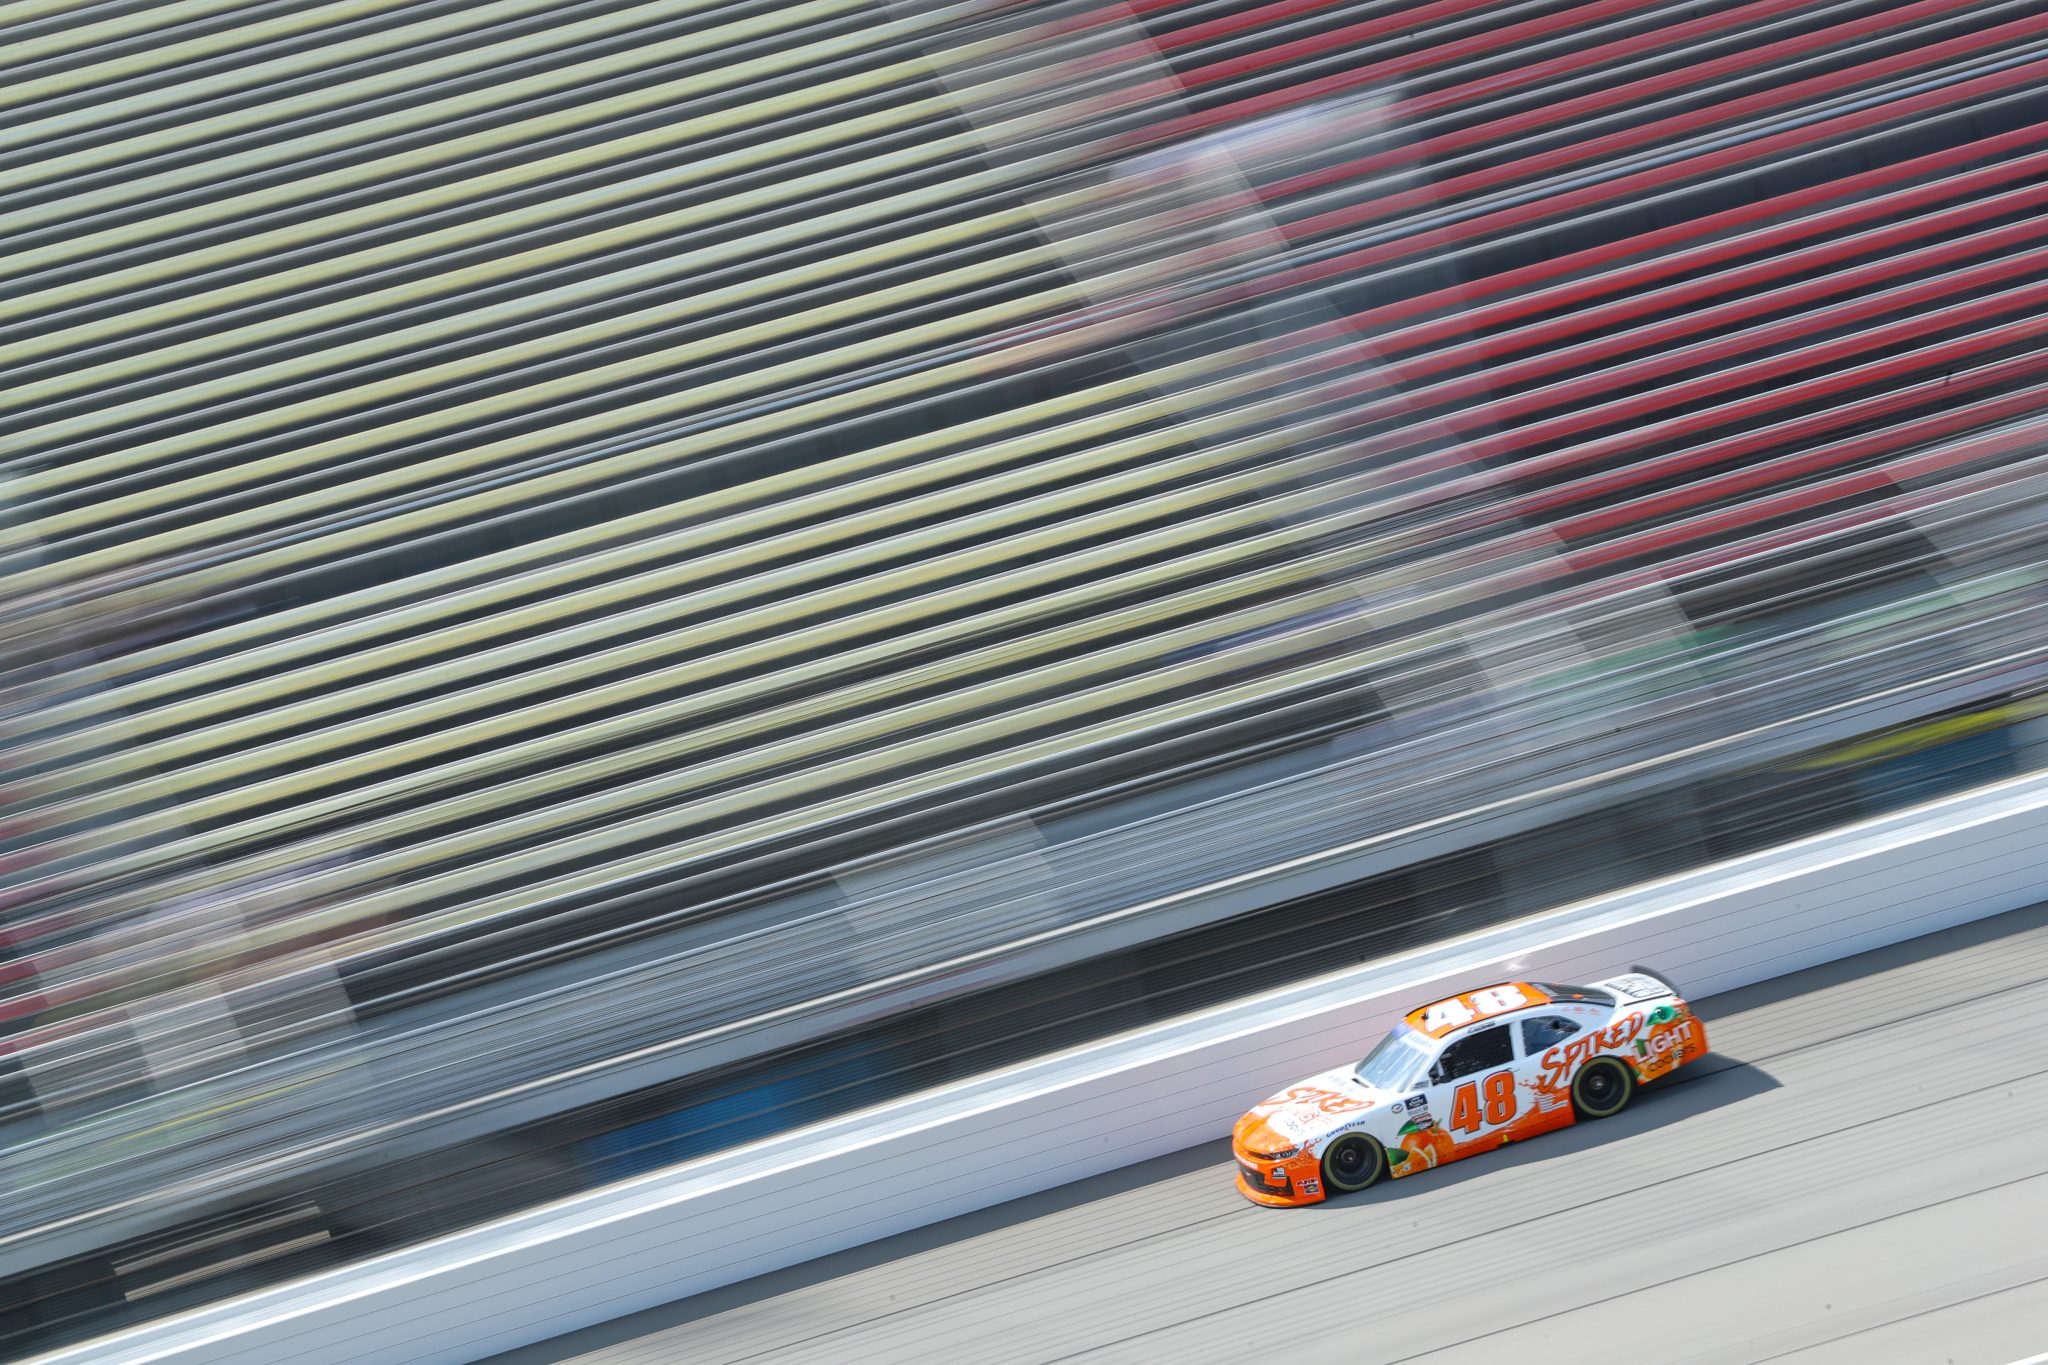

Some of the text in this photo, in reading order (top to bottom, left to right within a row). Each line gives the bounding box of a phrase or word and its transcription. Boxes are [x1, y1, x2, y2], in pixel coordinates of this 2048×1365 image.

[1424, 985, 1528, 1033] 48
[1536, 1011, 1644, 1092] SPIKED
[1631, 1020, 1694, 1065] LIGHT
[1450, 1071, 1516, 1135] 48
[1326, 1120, 1366, 1138] GOODYEAR
